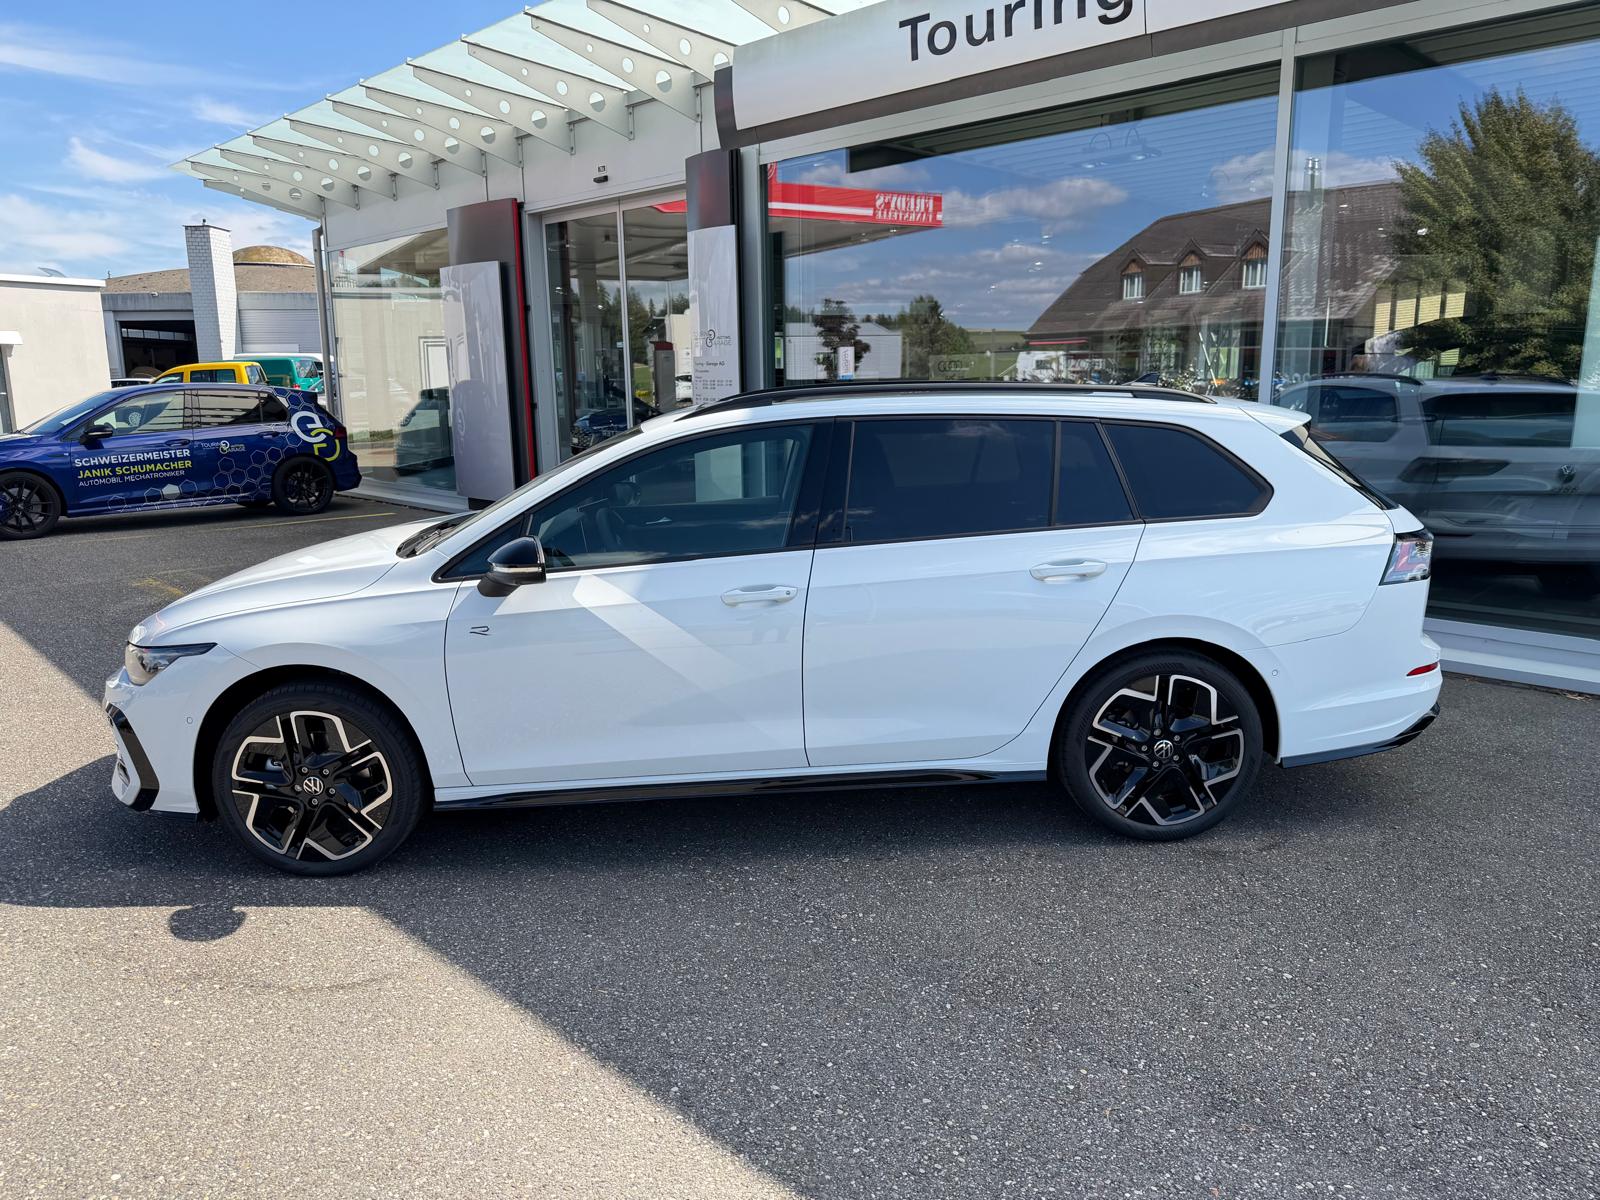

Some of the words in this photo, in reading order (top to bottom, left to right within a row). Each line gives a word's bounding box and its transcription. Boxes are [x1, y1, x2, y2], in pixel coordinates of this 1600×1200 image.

[74, 449, 191, 467] SCHWEIZERMEISTER
[77, 467, 113, 479] JANIK
[115, 460, 193, 475] SCHUMACHER
[79, 476, 122, 487] AUTOMOBIL
[124, 470, 185, 482] MECHATRONIKER
